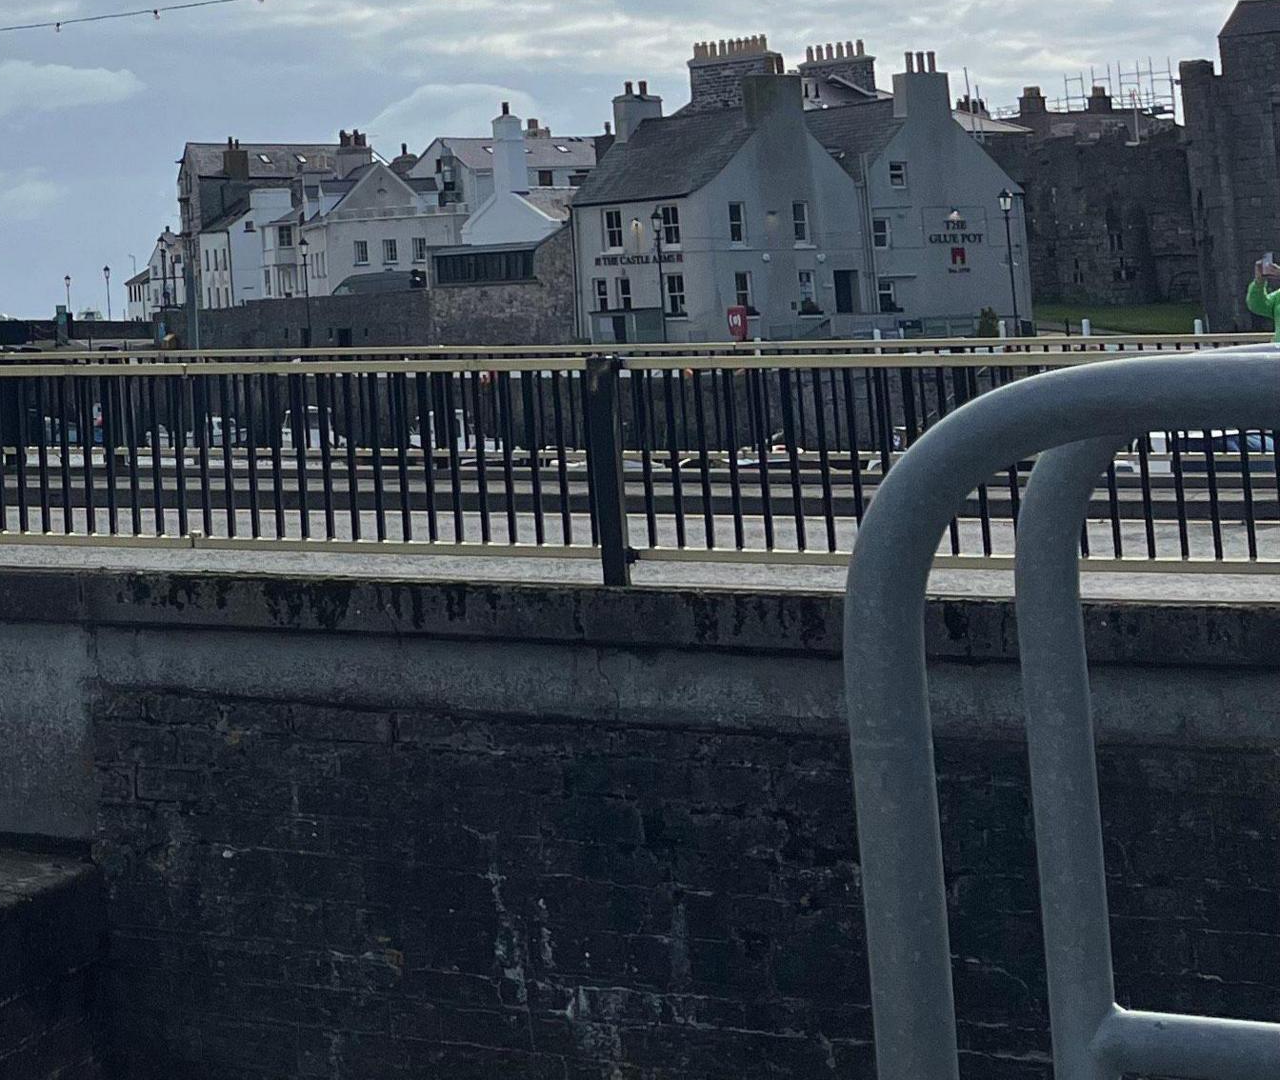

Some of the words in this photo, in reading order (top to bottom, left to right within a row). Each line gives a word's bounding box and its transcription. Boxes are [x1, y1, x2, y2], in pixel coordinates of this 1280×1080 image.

[943, 220, 967, 230] THE
[929, 233, 959, 244] GLUE
[961, 233, 984, 244] POT
[620, 254, 651, 265] CASTLE
